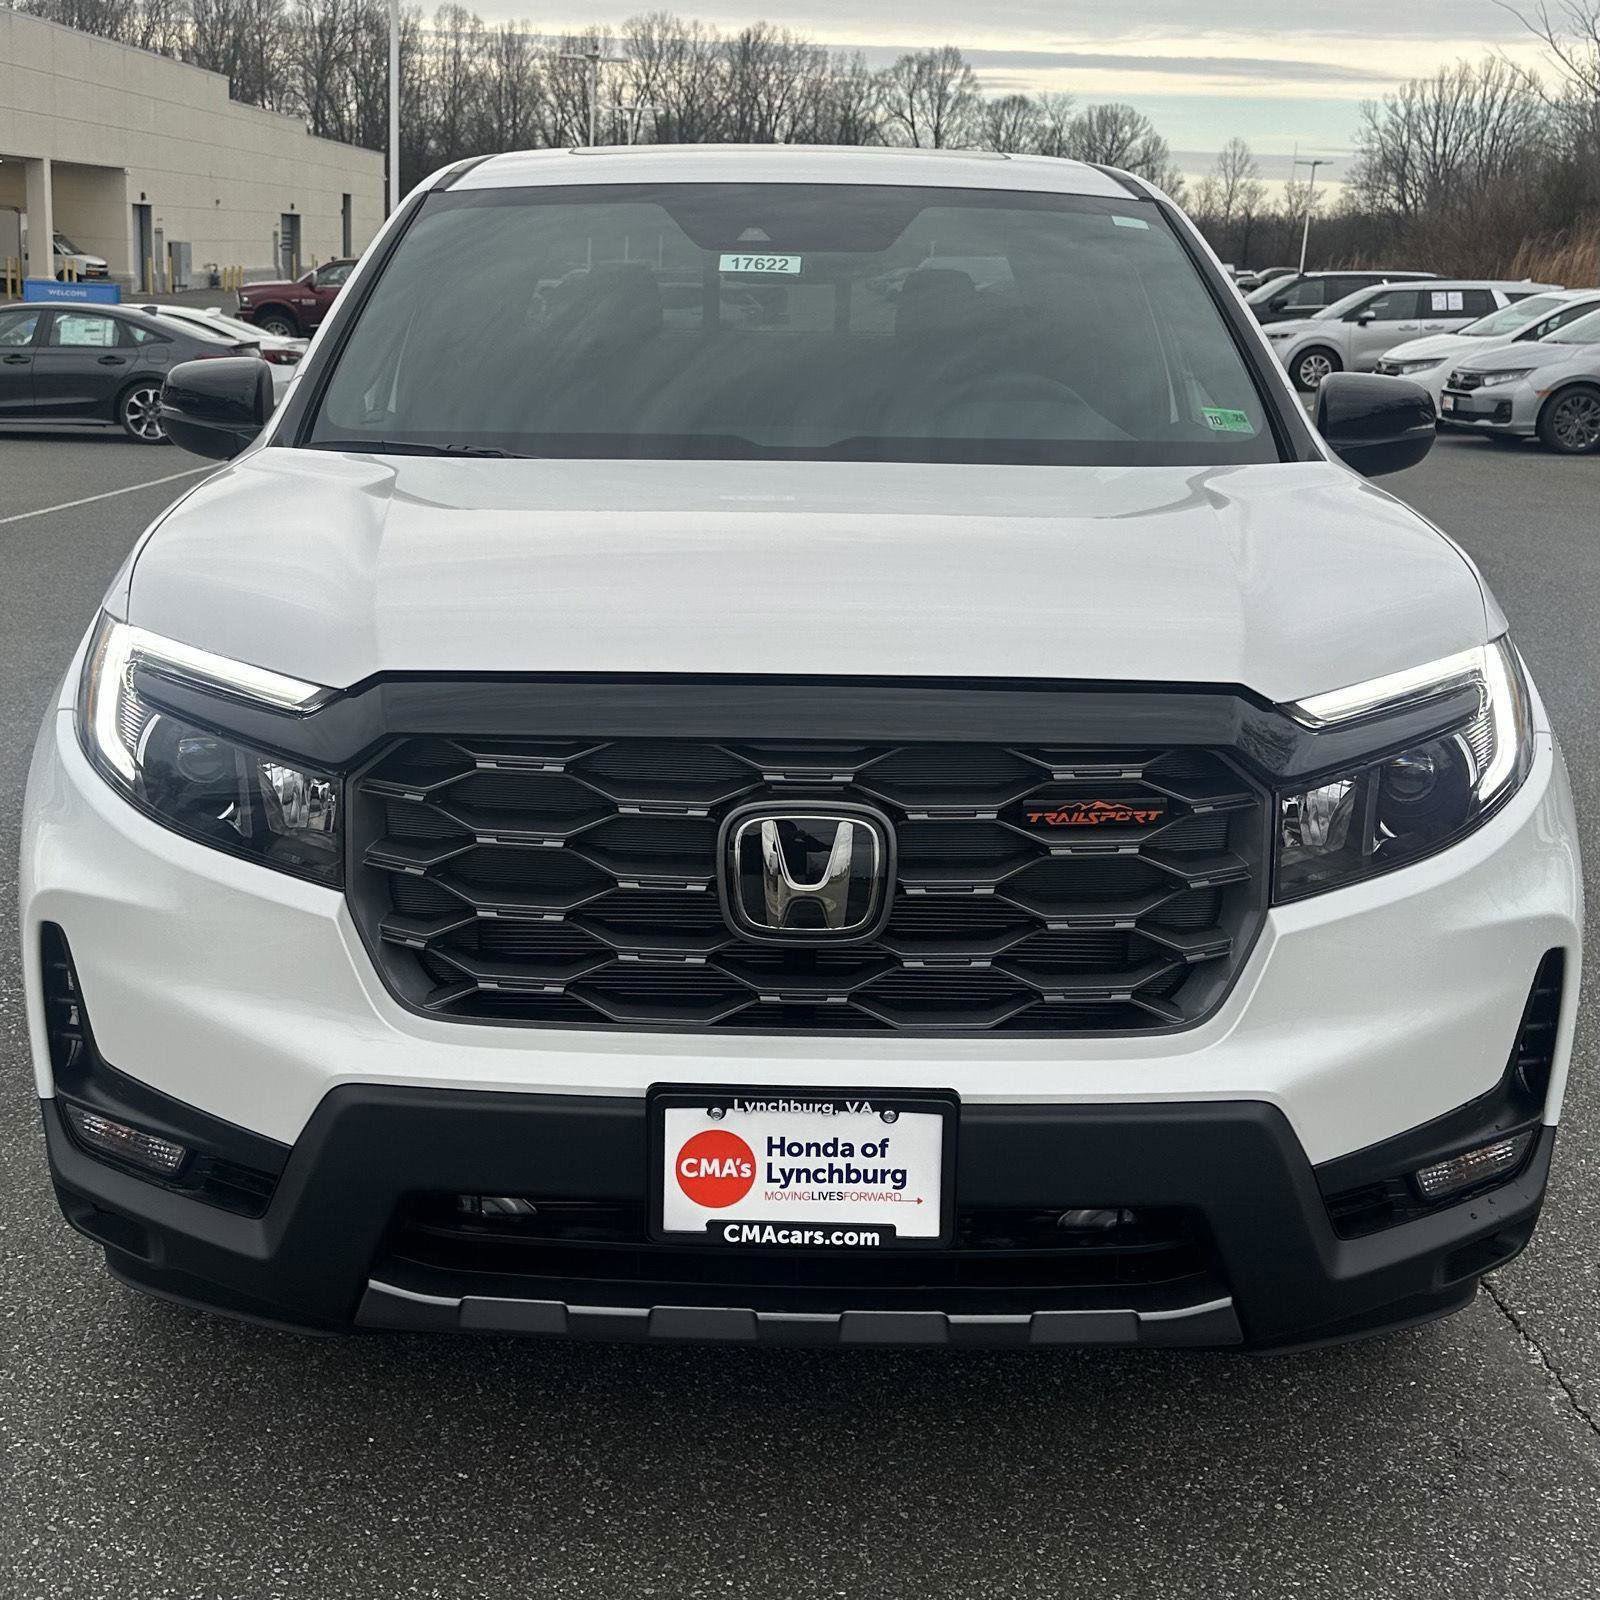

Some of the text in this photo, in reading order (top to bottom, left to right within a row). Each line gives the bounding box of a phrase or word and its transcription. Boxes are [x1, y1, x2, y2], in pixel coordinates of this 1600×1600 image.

[731, 257, 789, 271] 17622
[48, 289, 87, 297] WELCOME
[1208, 415, 1222, 425] 10
[1026, 811, 1164, 825] TRAILSPORT
[733, 1098, 873, 1116] Lynchburg, VA
[767, 1136, 890, 1158] Honda of
[680, 1157, 752, 1178] CMA's
[766, 1162, 907, 1190] Lynchburg
[723, 1224, 880, 1246] CMAcars.com
